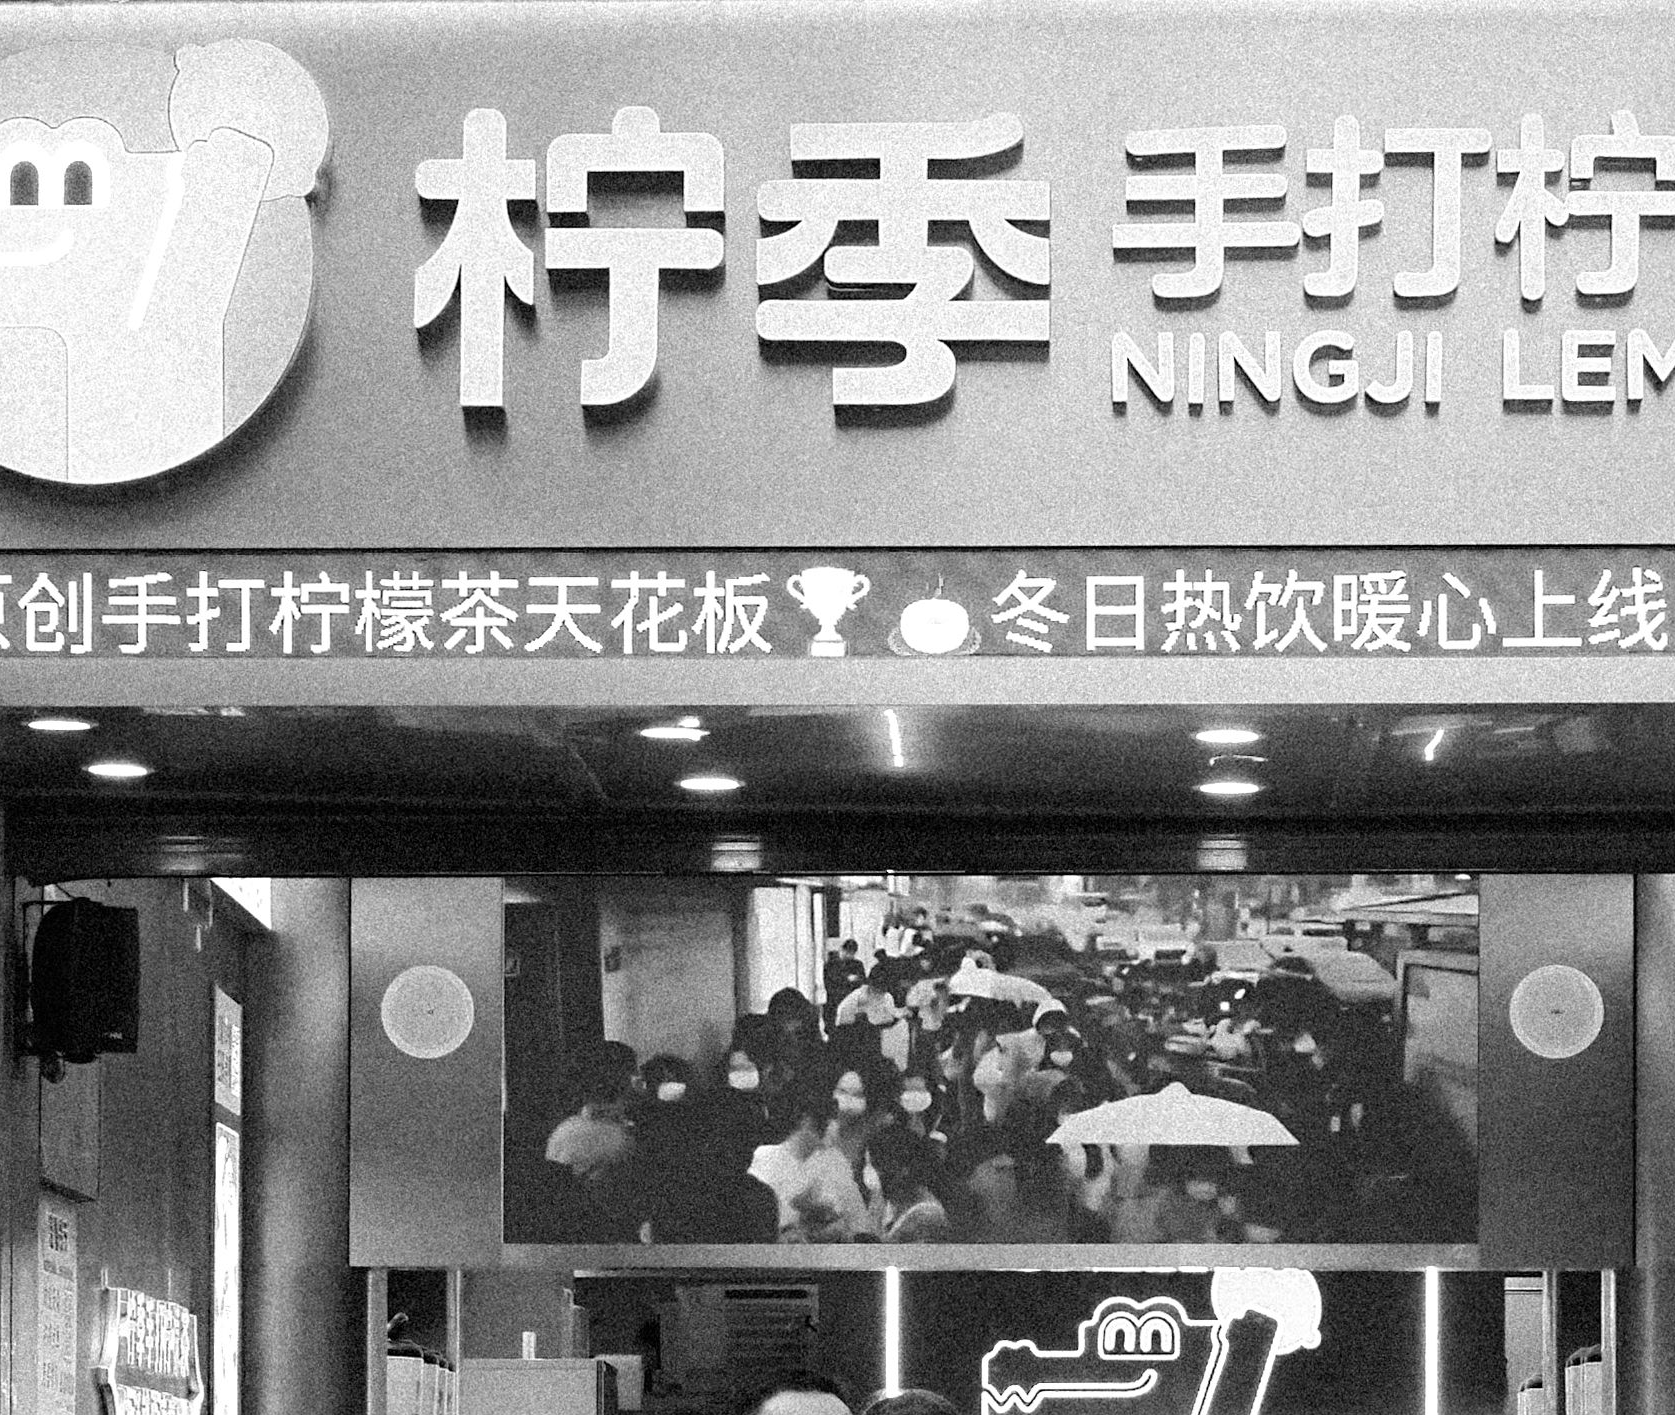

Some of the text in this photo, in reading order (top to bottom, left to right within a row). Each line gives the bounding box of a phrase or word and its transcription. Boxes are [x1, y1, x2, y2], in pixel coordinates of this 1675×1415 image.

[415, 106, 1052, 408] 柠季
[1112, 328, 1443, 404] NINGJI
[990, 568, 1669, 653] 冬日热饮暖心上线
